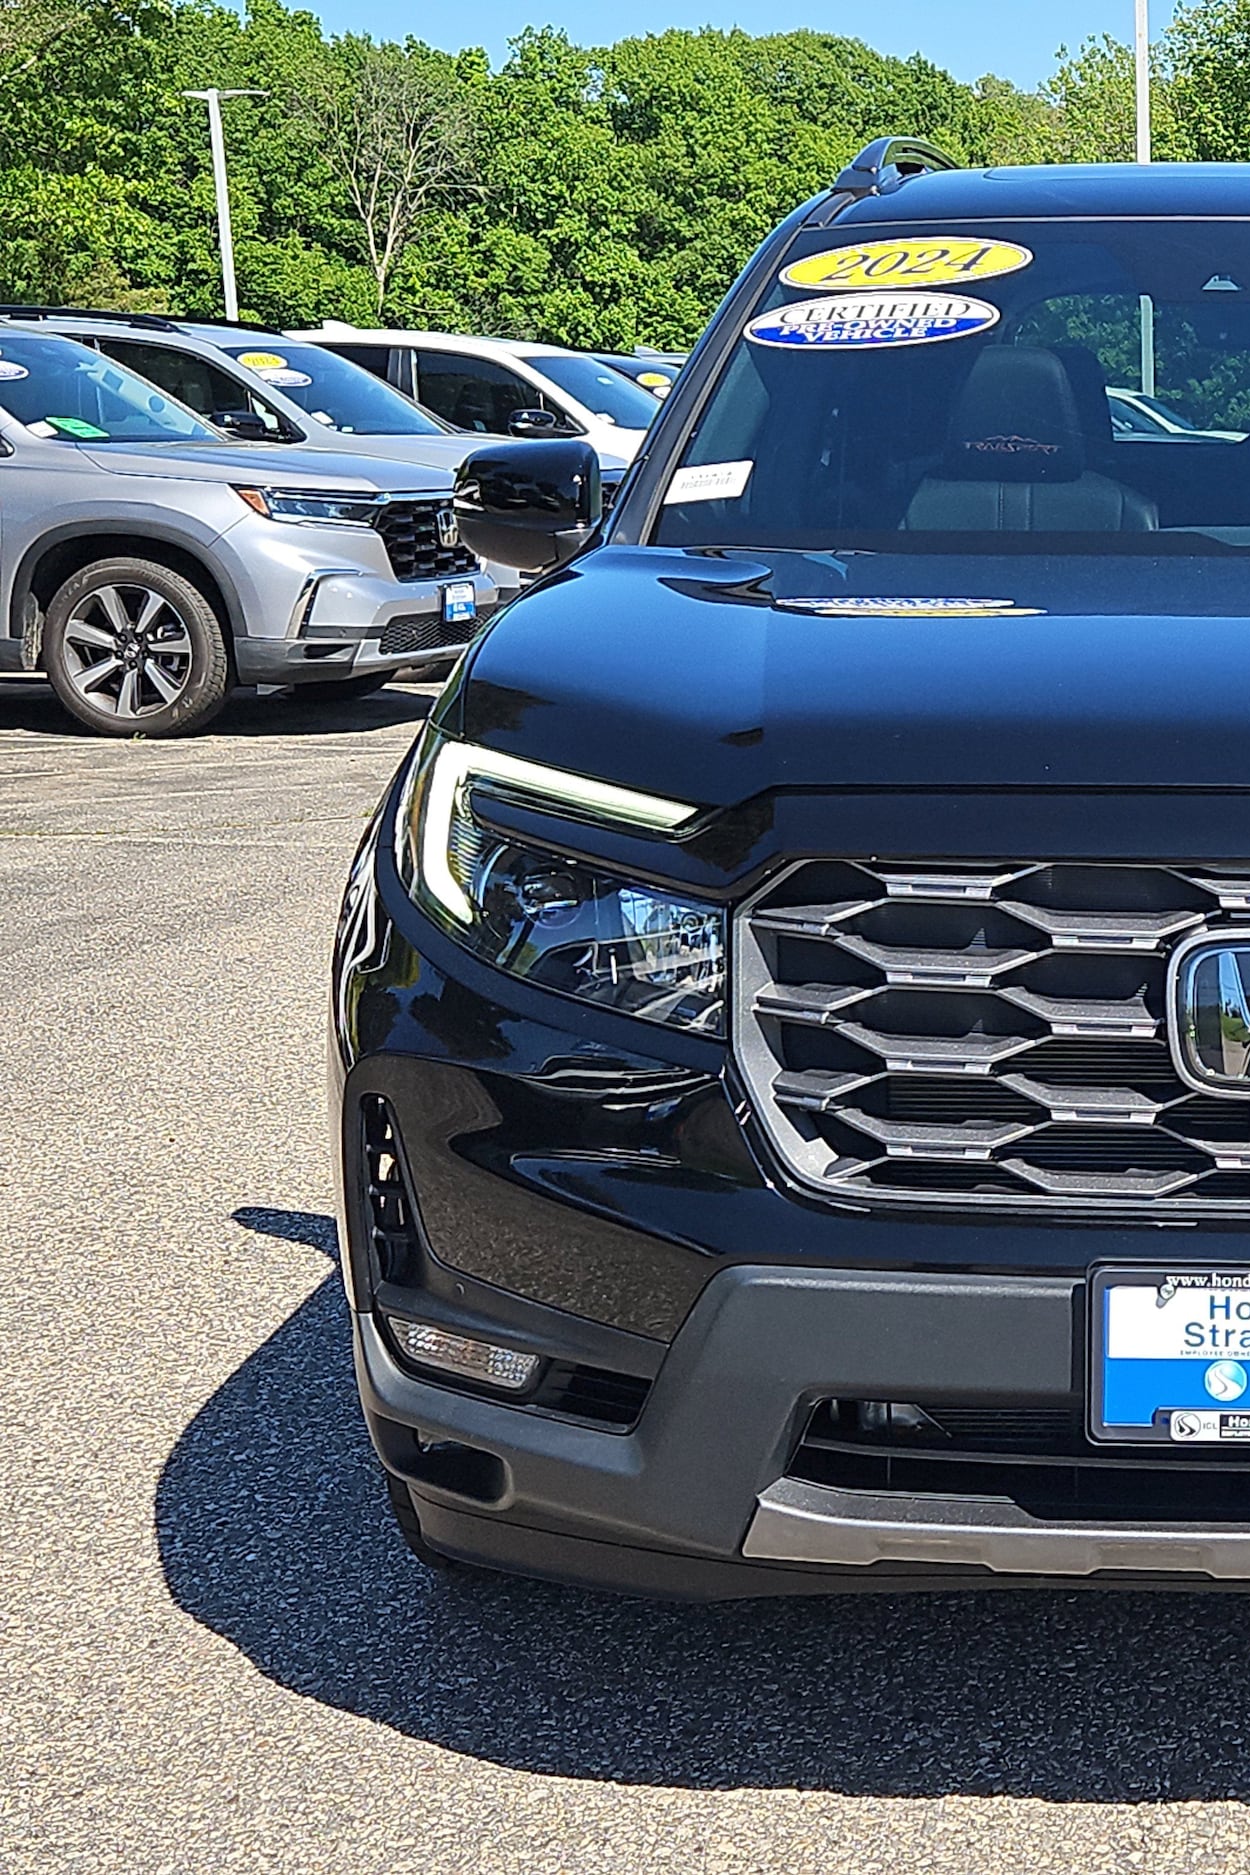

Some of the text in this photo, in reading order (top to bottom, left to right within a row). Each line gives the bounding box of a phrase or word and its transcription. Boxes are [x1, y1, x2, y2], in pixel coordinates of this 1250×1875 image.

[819, 246, 992, 282] 2024
[779, 302, 971, 324] CERTIFIED
[780, 318, 957, 336] PRE-OWNED
[803, 326, 930, 343] VEHICLE
[1202, 1421, 1218, 1430] ICL
